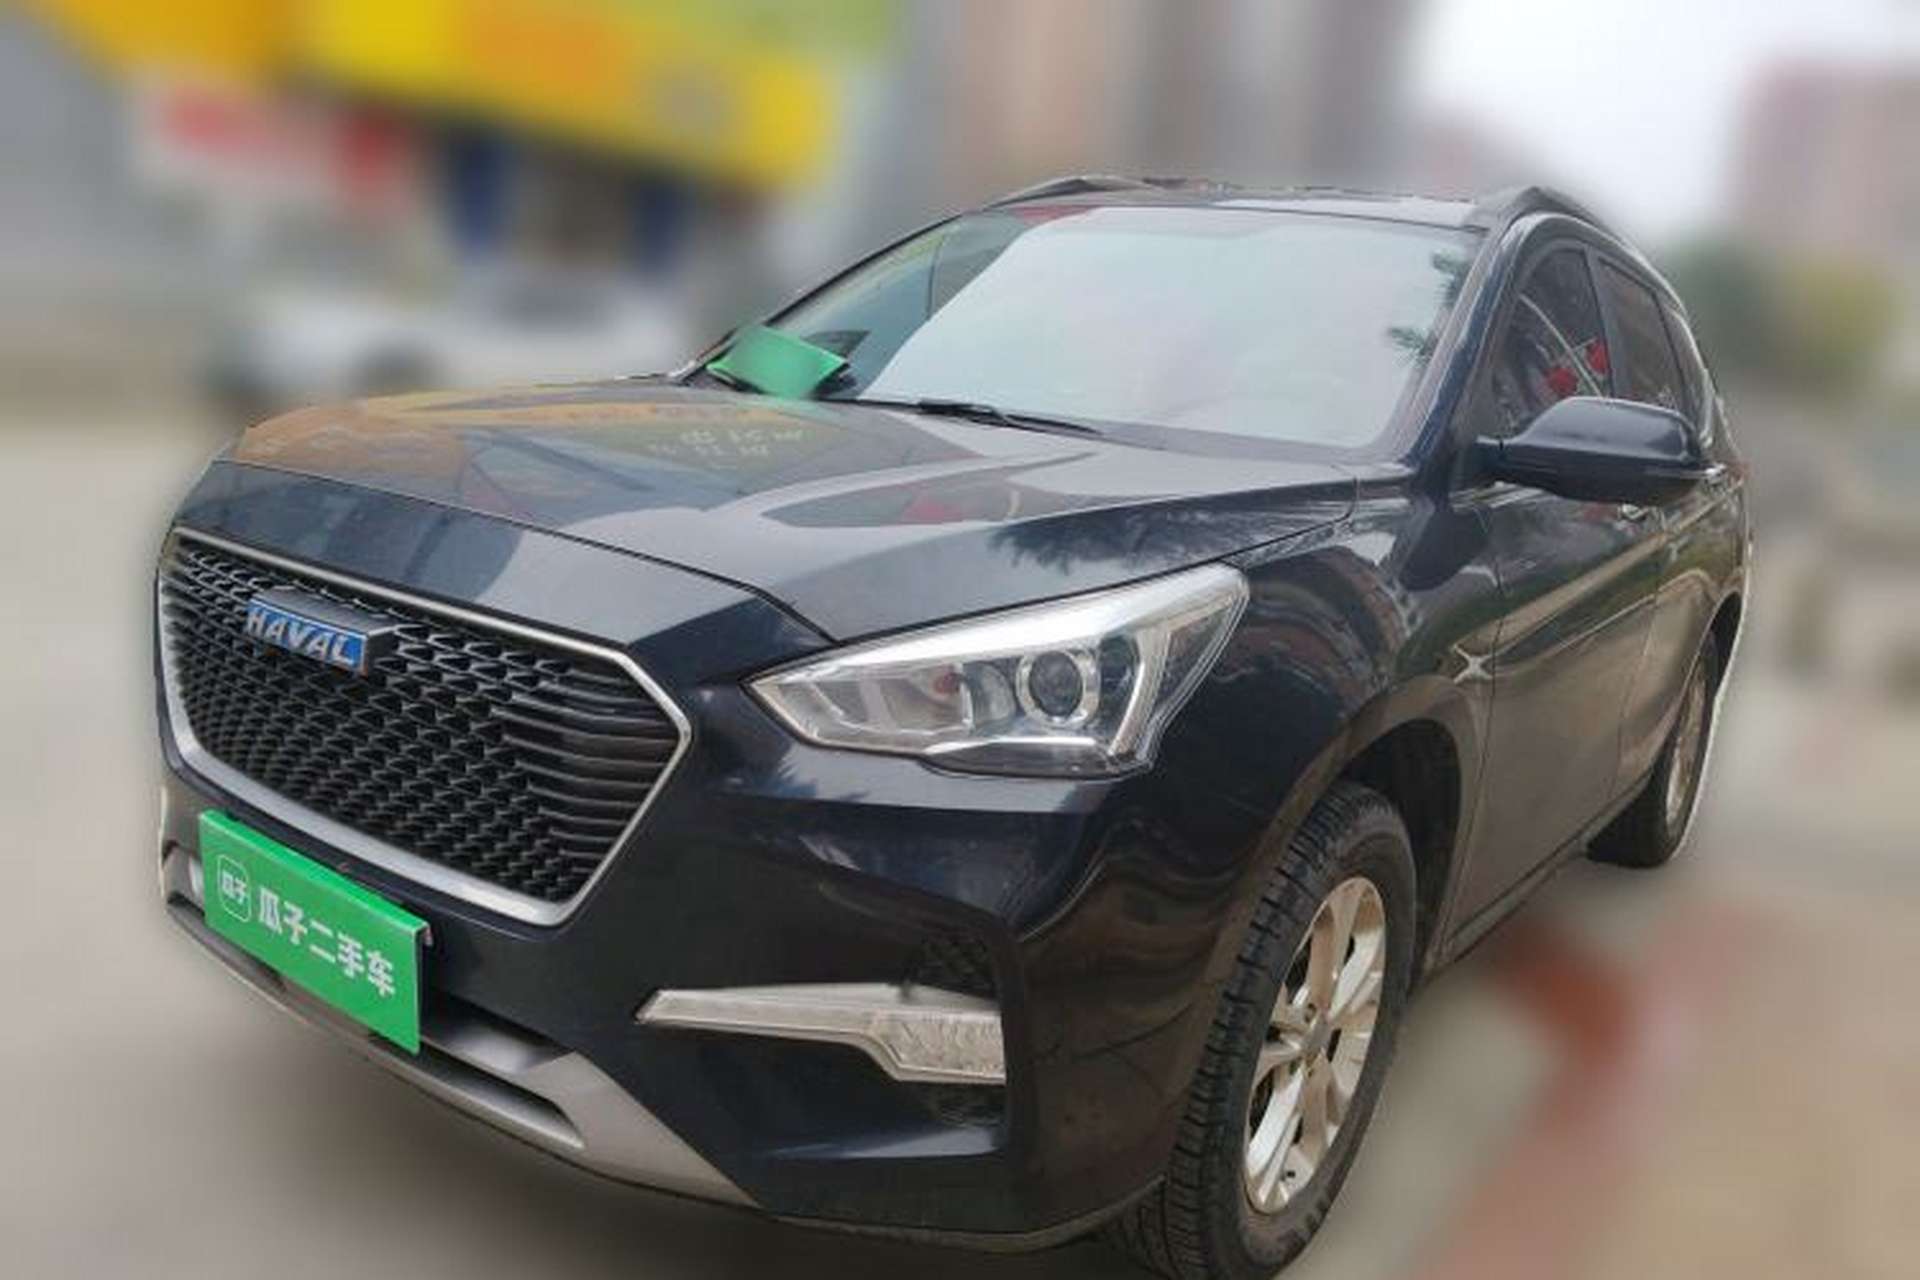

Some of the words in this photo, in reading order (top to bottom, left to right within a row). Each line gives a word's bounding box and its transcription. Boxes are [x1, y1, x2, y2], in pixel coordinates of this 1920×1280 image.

[246, 606, 355, 667] HAVAL
[258, 887, 397, 998] 瓜子二手车
